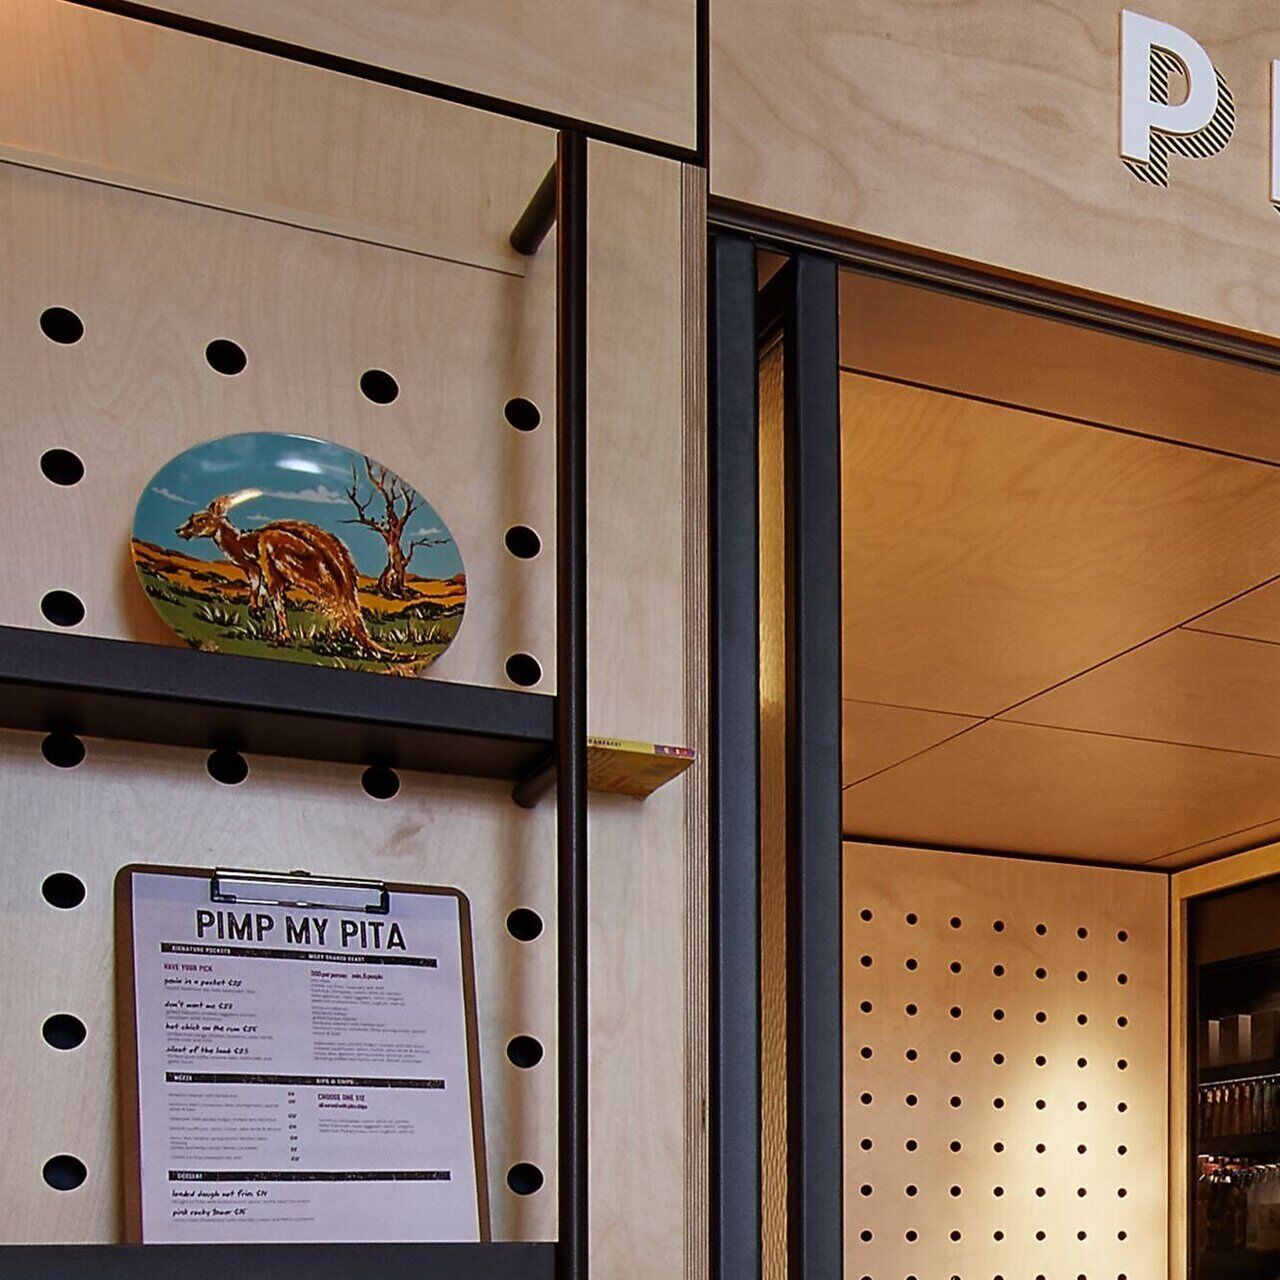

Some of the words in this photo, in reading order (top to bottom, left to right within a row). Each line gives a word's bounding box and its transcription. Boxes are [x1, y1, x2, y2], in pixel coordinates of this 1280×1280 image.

[196, 909, 274, 942] PIMP
[285, 915, 328, 946] MY
[341, 919, 407, 950] PITA
